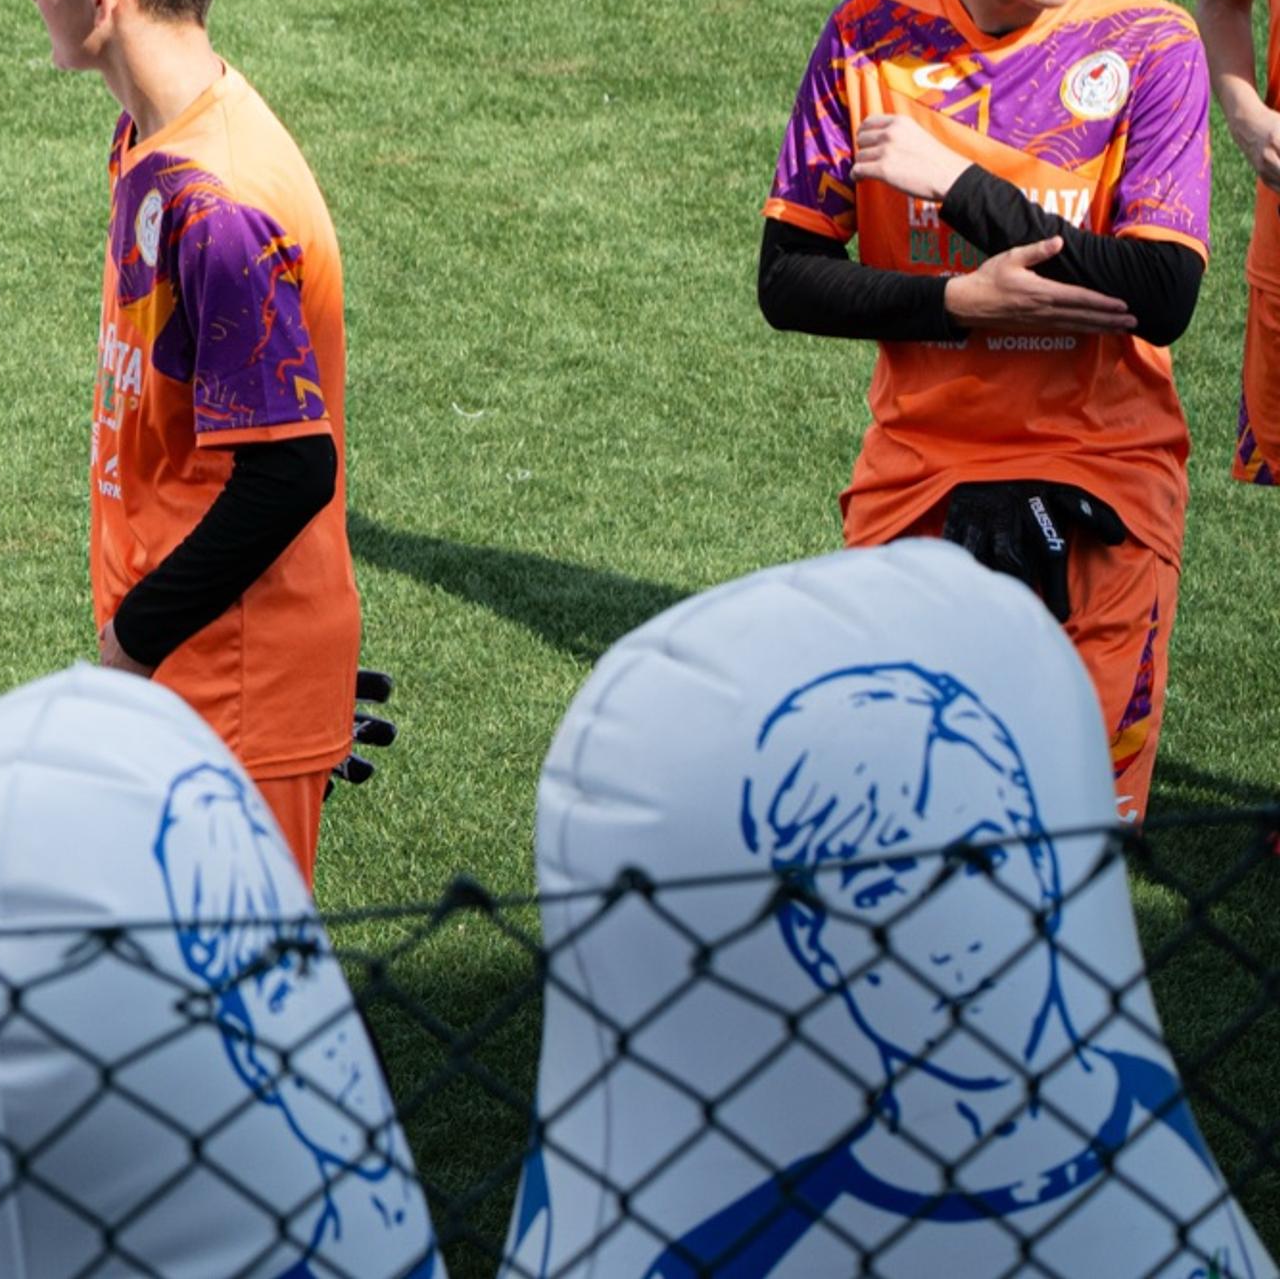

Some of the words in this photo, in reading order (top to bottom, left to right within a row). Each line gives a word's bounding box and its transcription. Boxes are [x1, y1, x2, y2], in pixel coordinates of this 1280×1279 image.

[907, 197, 939, 229] LA
[986, 336, 1077, 350] WORKOND
[1028, 496, 1065, 552] reusch
